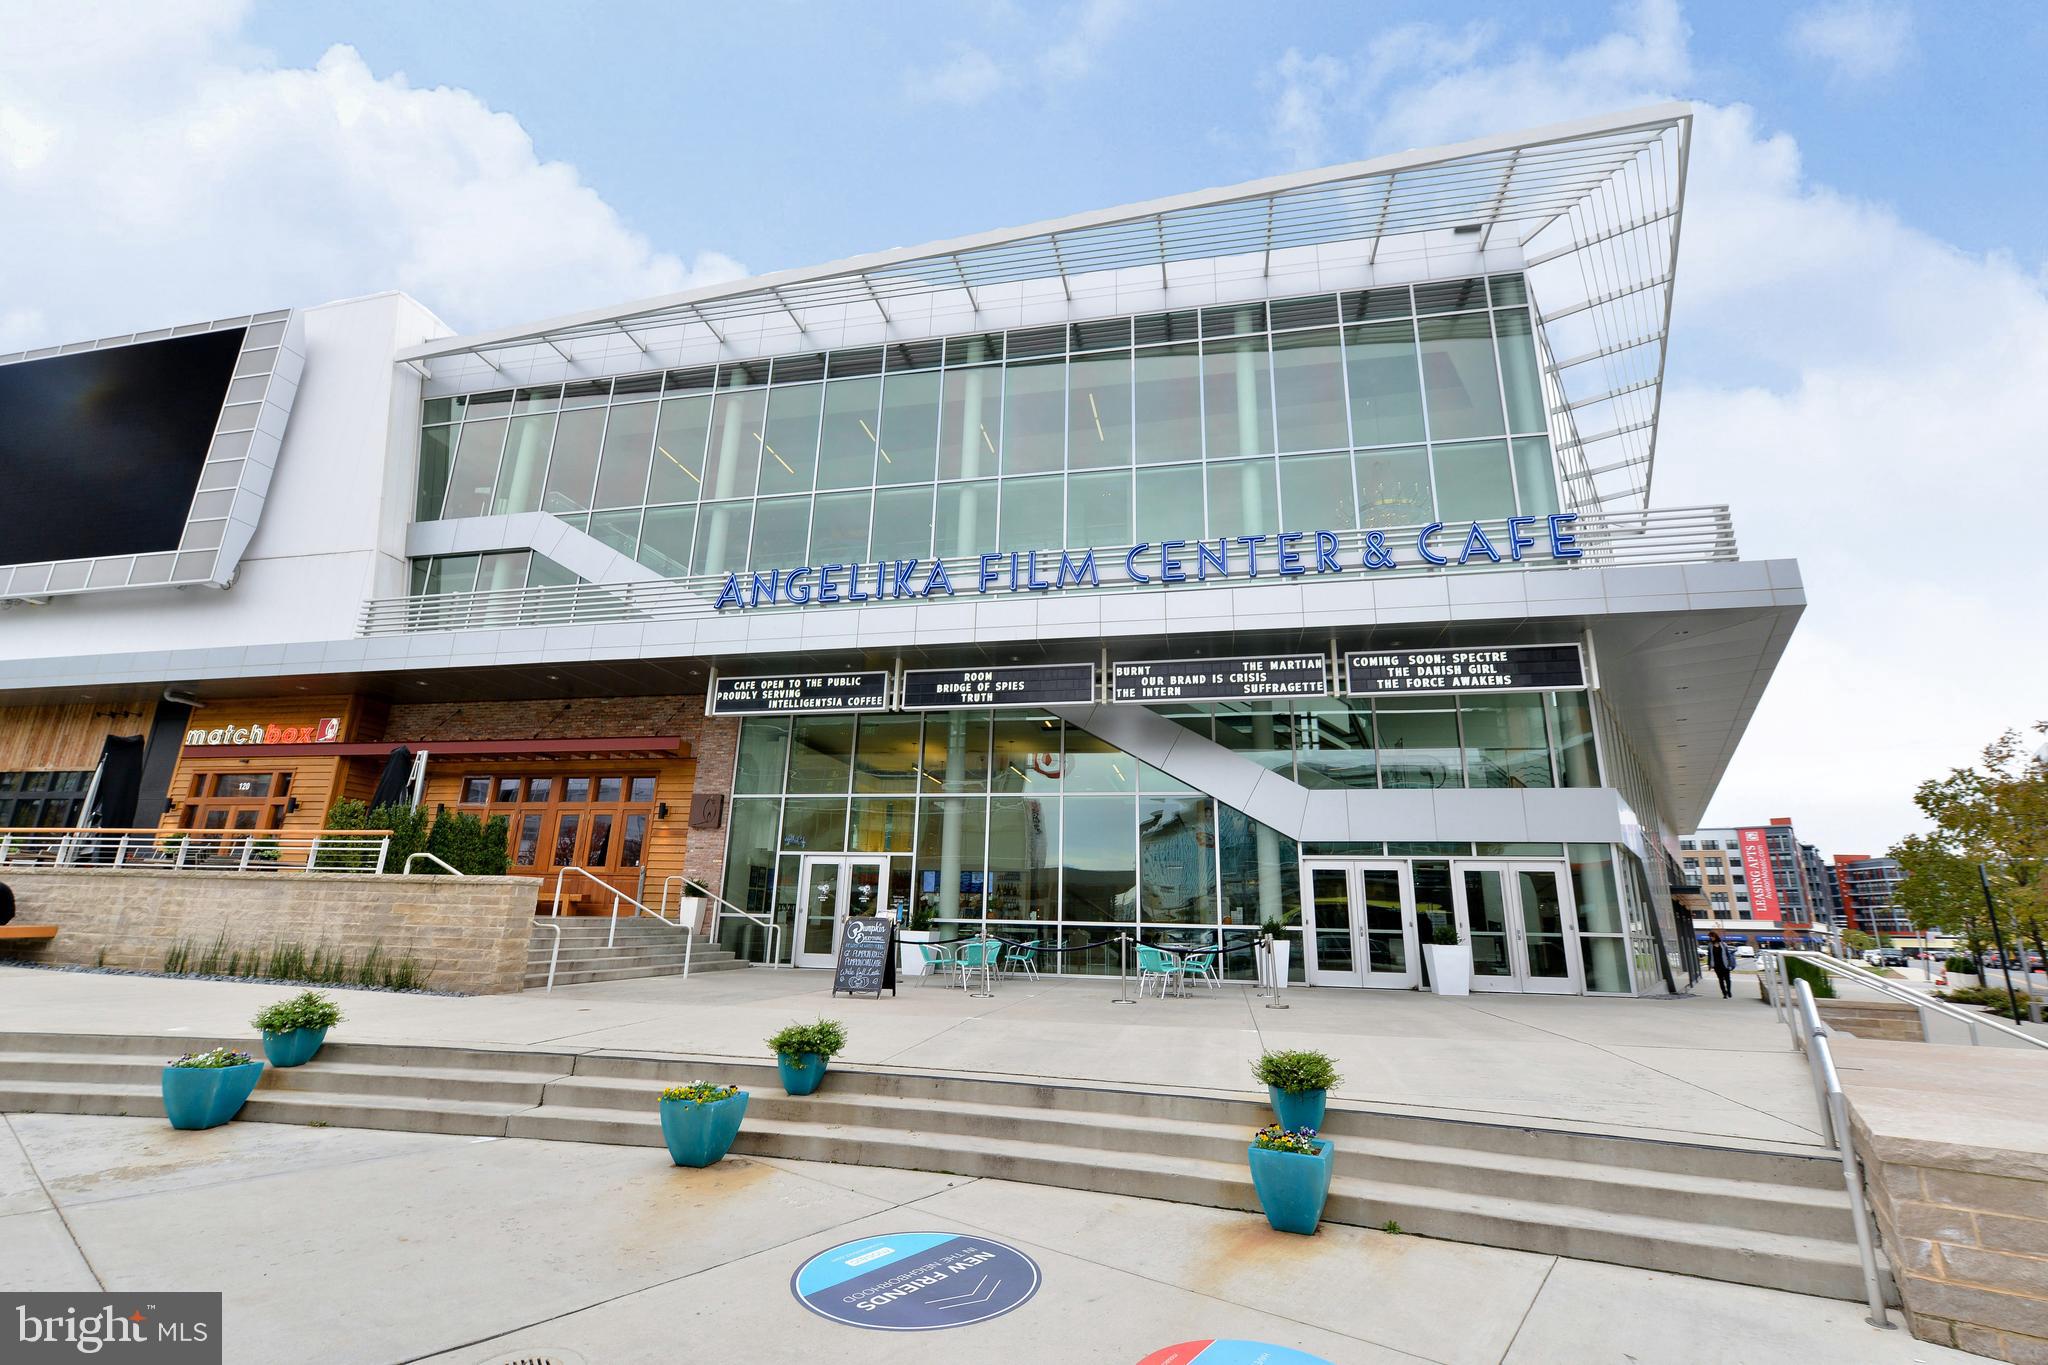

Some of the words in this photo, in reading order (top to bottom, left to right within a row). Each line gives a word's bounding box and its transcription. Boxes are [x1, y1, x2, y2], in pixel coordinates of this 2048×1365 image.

[714, 557, 955, 609] ANGELIKA
[979, 547, 1100, 593] FILM
[1125, 530, 1343, 583] CENTER
[1363, 530, 1396, 569] &
[1416, 513, 1583, 565] CAFE
[1242, 662, 1264, 672] THE
[1270, 659, 1322, 670] MARTIAN
[1353, 656, 1399, 667] COMING
[1408, 654, 1446, 665] SOON:
[1452, 652, 1508, 663] SPECTRE
[964, 672, 993, 682] ROOM
[1116, 666, 1151, 676] BURNT
[1387, 667, 1410, 677] THE
[1417, 665, 1462, 676] DANISH
[1468, 664, 1497, 674] GIRL
[734, 681, 756, 691] CAFE
[761, 680, 784, 690] OPEN
[789, 679, 801, 688] TO
[806, 678, 823, 687] THE
[827, 677, 861, 686] PUBLIC
[1141, 676, 1164, 686] OUR
[1170, 674, 1206, 685] BRAND
[1212, 674, 1224, 684] IS
[1229, 672, 1267, 683] CRISIS
[1377, 679, 1400, 689] THE
[1406, 677, 1445, 688] FORCE
[1452, 675, 1512, 687] AWAKENS
[936, 682, 972, 693] BRIDGE
[977, 682, 990, 692] OF
[995, 681, 1025, 691] SPIES
[1116, 688, 1136, 698] THE
[1142, 686, 1181, 697] INTERN
[1243, 681, 1324, 694] SUFFRAGETTE
[717, 690, 758, 700] PROUDLY
[762, 689, 801, 699] SERVING
[961, 692, 993, 703] TRUTH
[768, 697, 842, 709] INTELLIGENTSIA
[847, 696, 882, 706] COFFEE
[185, 723, 315, 745] matchbox
[238, 782, 251, 791] 120
[1745, 844, 1759, 869] APTS
[1749, 870, 1767, 912] LEASING
[938, 1248, 964, 1264] THE
[964, 1246, 979, 1256] IN
[948, 1251, 996, 1275] NEW
[842, 1261, 942, 1304] NEIGHBORHOOD
[856, 1271, 950, 1311] FRIENDS
